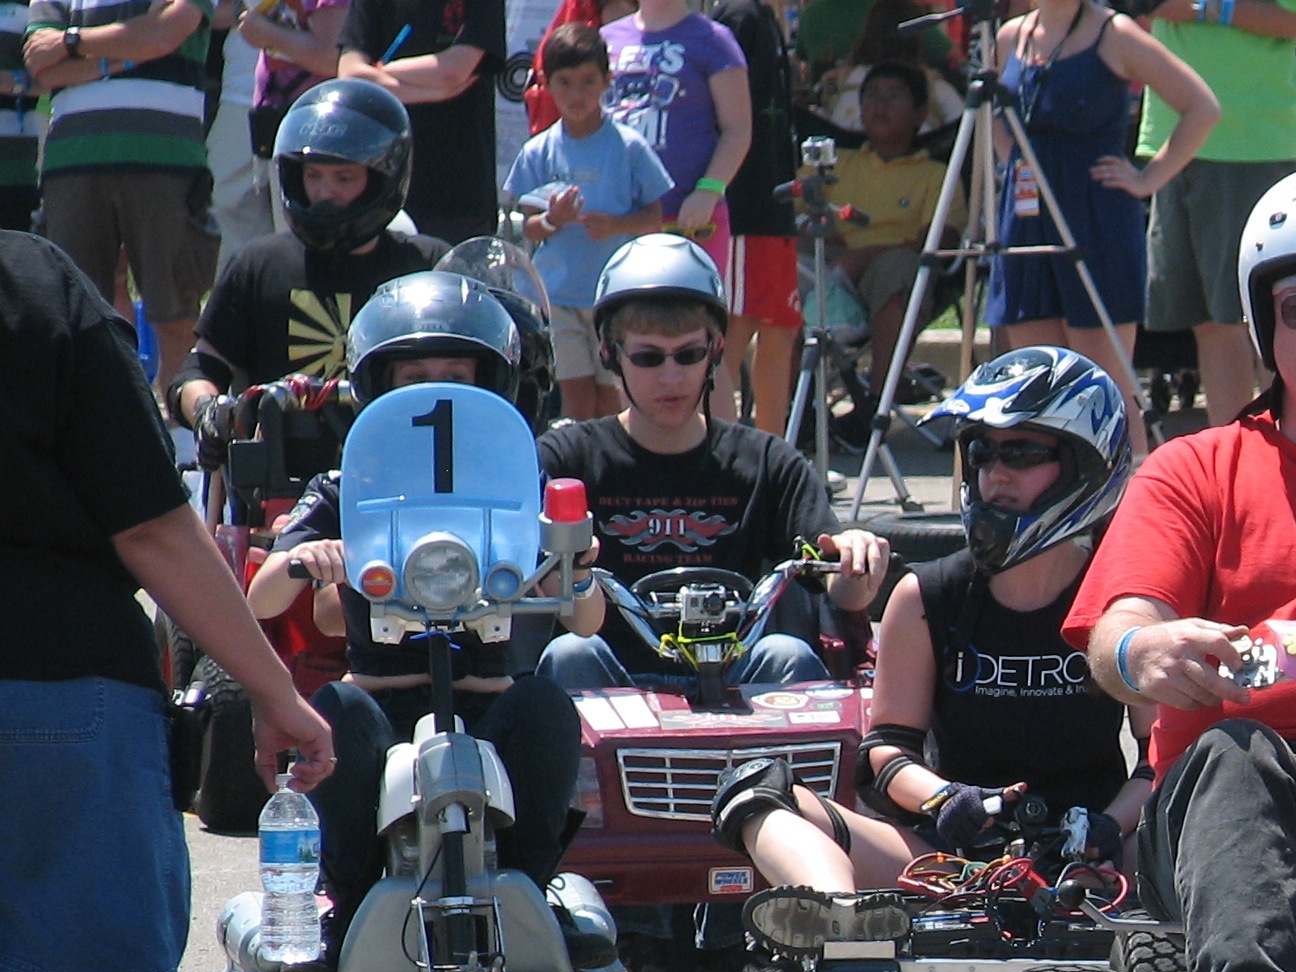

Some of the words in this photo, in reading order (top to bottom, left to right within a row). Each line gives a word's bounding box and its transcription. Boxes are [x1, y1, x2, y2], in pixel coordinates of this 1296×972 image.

[411, 399, 453, 494] 1
[600, 497, 631, 506] DUCT
[635, 497, 668, 506] TAPE
[672, 497, 682, 506] &
[711, 497, 738, 506] TIES
[648, 518, 686, 536] 911
[623, 554, 673, 563] RACING
[677, 554, 713, 563] TEAM
[975, 686, 1017, 698] Imagine,
[1020, 687, 1063, 697] Innovate
[1066, 685, 1073, 695] &
